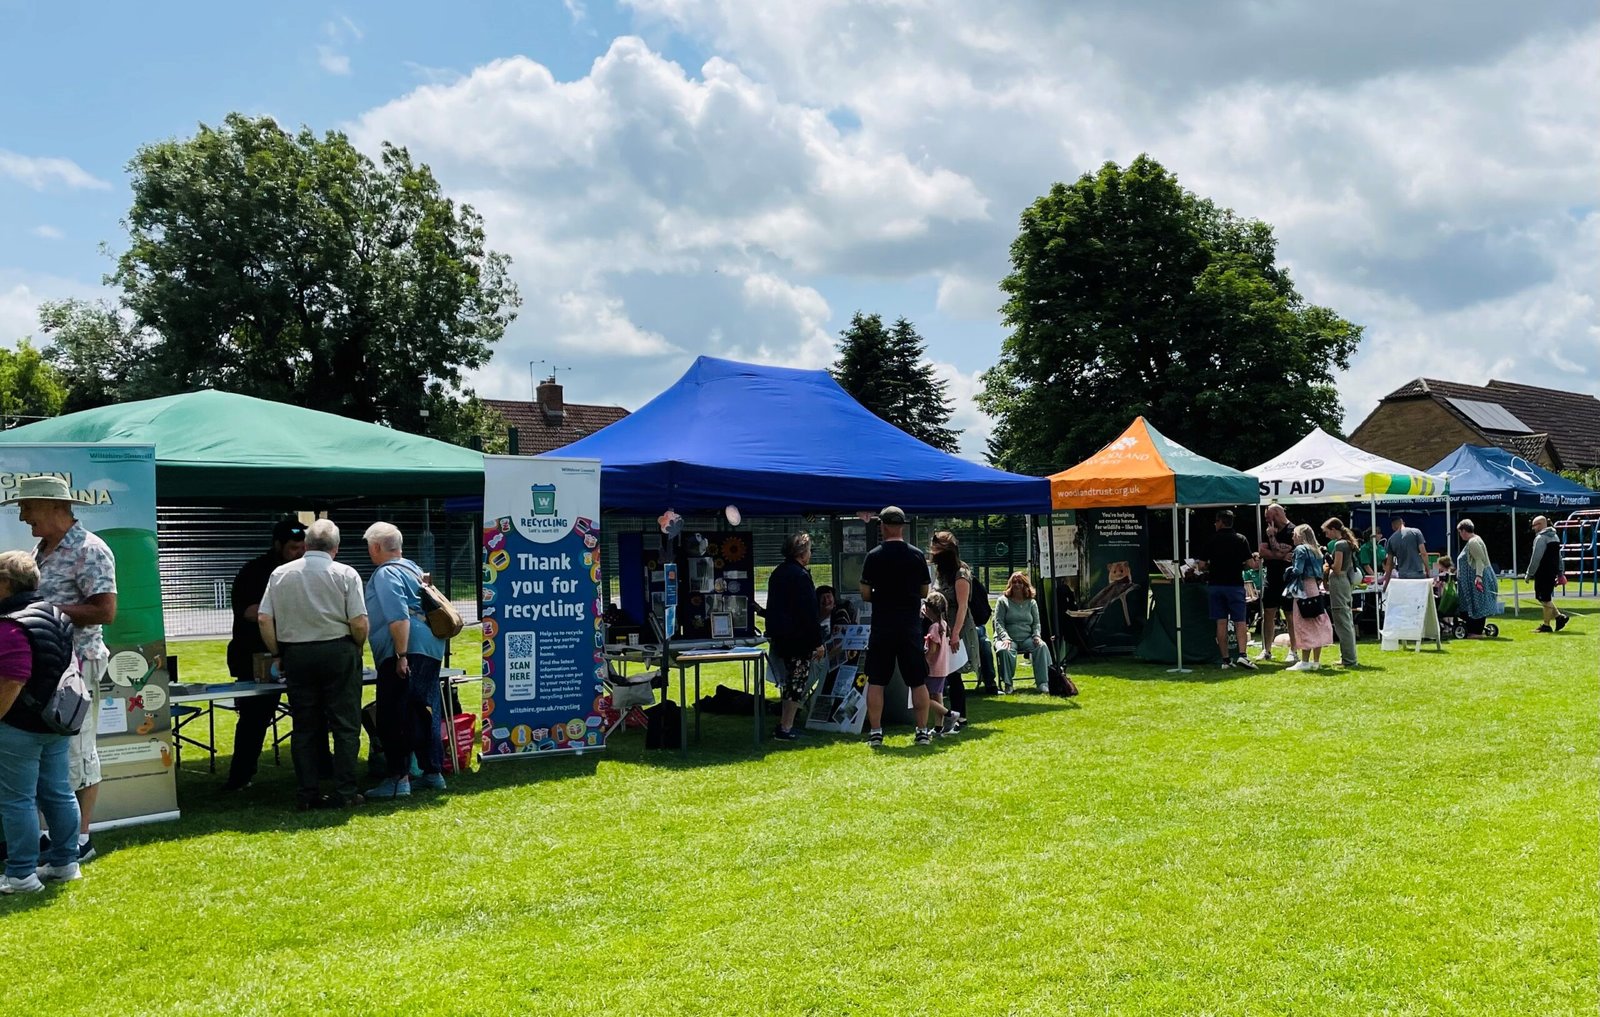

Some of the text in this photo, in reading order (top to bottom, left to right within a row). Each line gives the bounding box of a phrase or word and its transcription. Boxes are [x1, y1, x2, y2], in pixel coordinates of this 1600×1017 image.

[1057, 485, 1140, 498] woodlandtrust.org.uk
[1290, 478, 1325, 495] AID
[1540, 493, 1590, 507] Butterfly Conservation
[521, 518, 568, 527] RECYCLING
[517, 553, 571, 570] Thank
[511, 577, 578, 598] you for
[504, 600, 585, 621] recycling
[510, 661, 530, 670] SCAN
[510, 672, 530, 681] HERE
[510, 704, 580, 714] wiltshire.gov.uk/recycling
